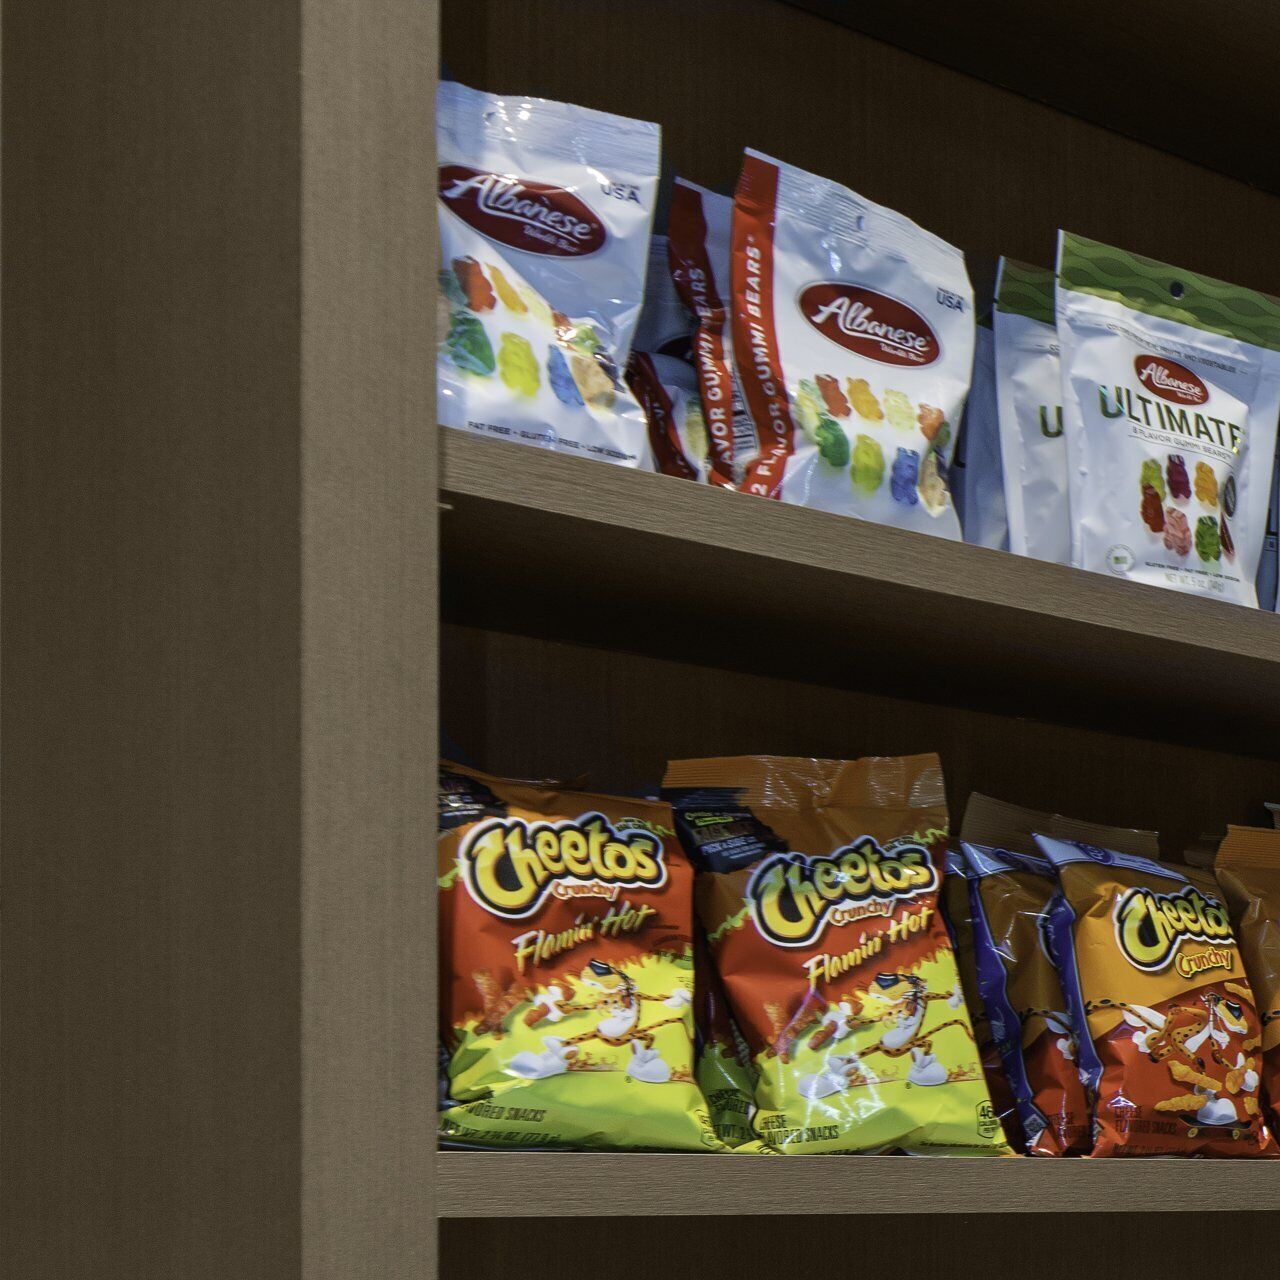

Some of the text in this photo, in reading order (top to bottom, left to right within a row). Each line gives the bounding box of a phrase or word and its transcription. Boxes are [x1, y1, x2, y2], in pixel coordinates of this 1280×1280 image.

[441, 174, 593, 241] Albanese
[601, 183, 641, 203] USA
[935, 291, 965, 312] USA
[745, 246, 776, 397] GUMMI BEARS
[811, 295, 929, 352] Albanese
[1139, 362, 1203, 397] Albanese
[1100, 385, 1243, 454] ULTIMATE
[1139, 430, 1171, 445] FLAVOR
[1173, 437, 1204, 451] GUMMI
[470, 815, 662, 911] Cheetos
[552, 881, 620, 902] Crunchy
[757, 842, 933, 940] Cheetos
[828, 899, 897, 926] Crunchy
[511, 899, 658, 973] Flamin' Hot
[803, 906, 935, 993] Flamin' Hot
[1176, 948, 1232, 978] Crunchy
[504, 1106, 547, 1123] SNACKS
[804, 1125, 840, 1143] SNACKS
